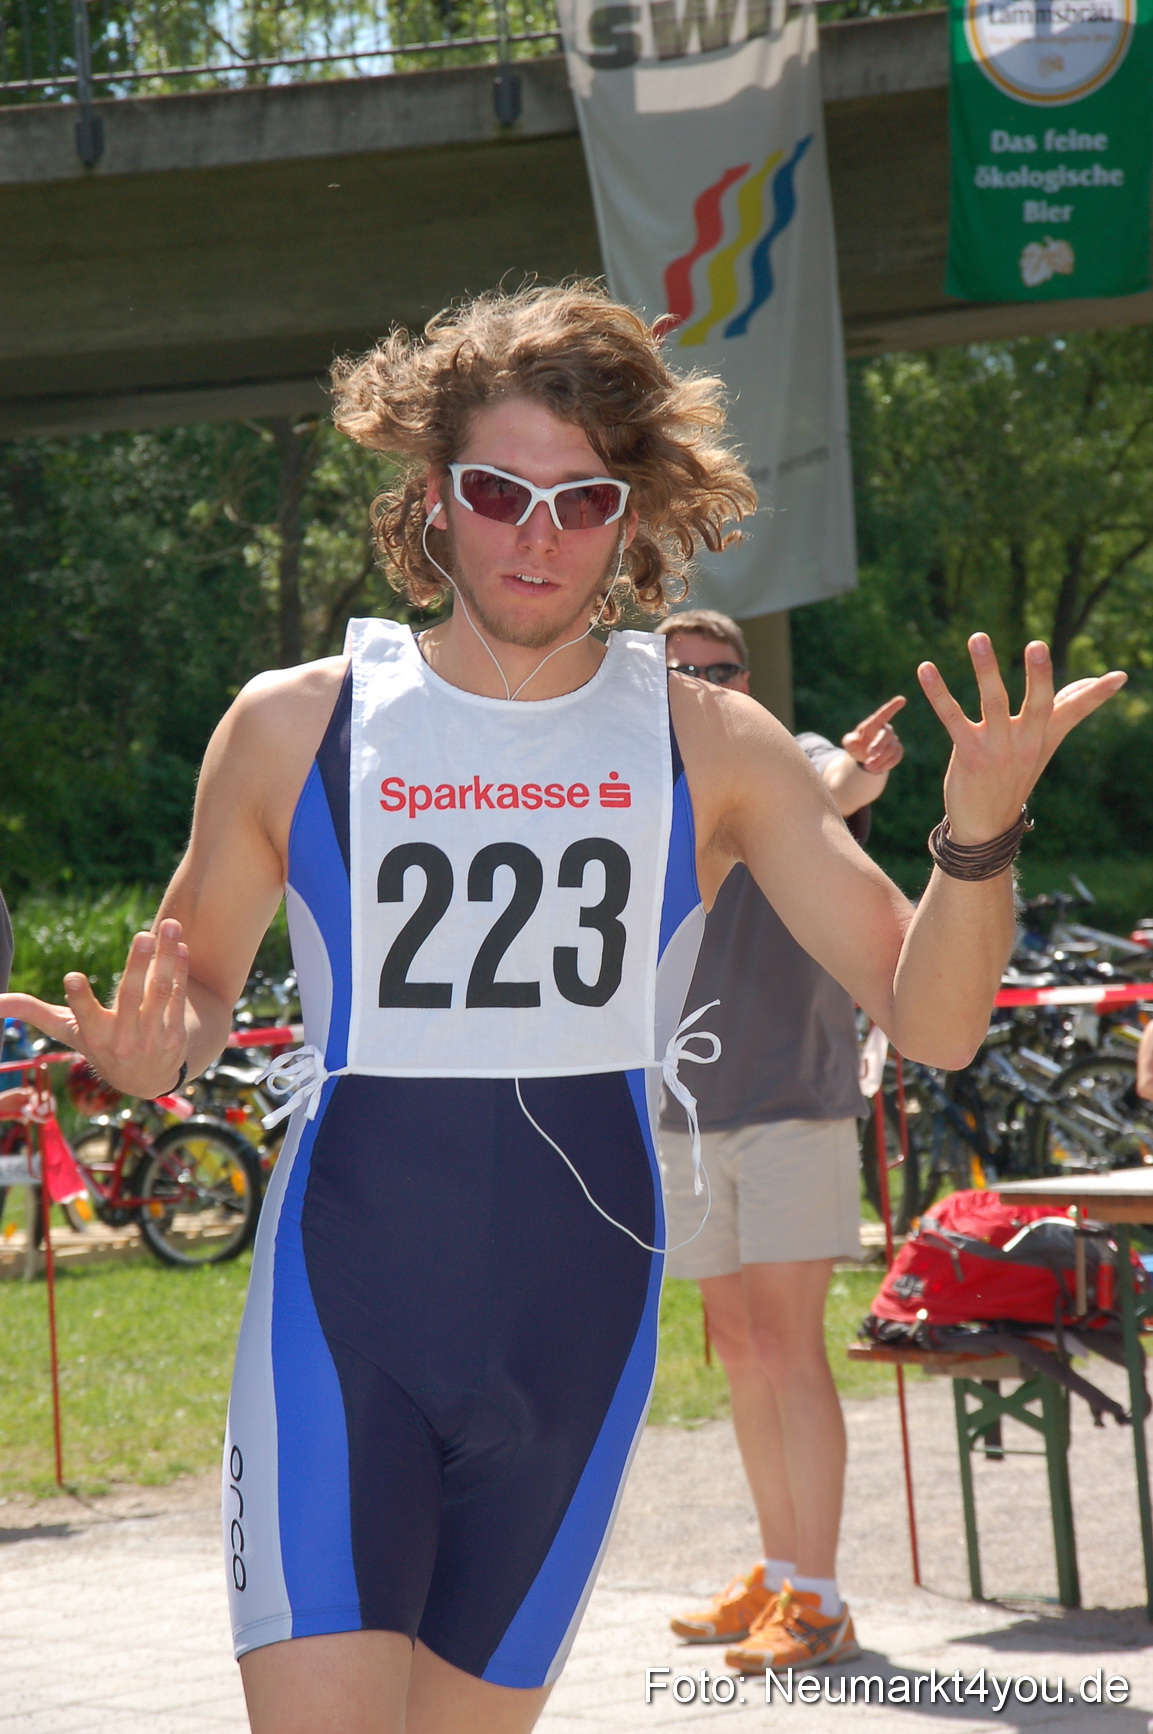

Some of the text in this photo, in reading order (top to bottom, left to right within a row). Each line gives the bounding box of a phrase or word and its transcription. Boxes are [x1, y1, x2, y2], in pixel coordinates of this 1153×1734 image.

[990, 128, 1108, 153] Das feine
[974, 164, 1125, 194] ökologische
[1022, 199, 1075, 223] Bier
[379, 775, 590, 819] Sparkasse
[377, 837, 632, 1009] 223
[230, 1444, 247, 1592] orca
